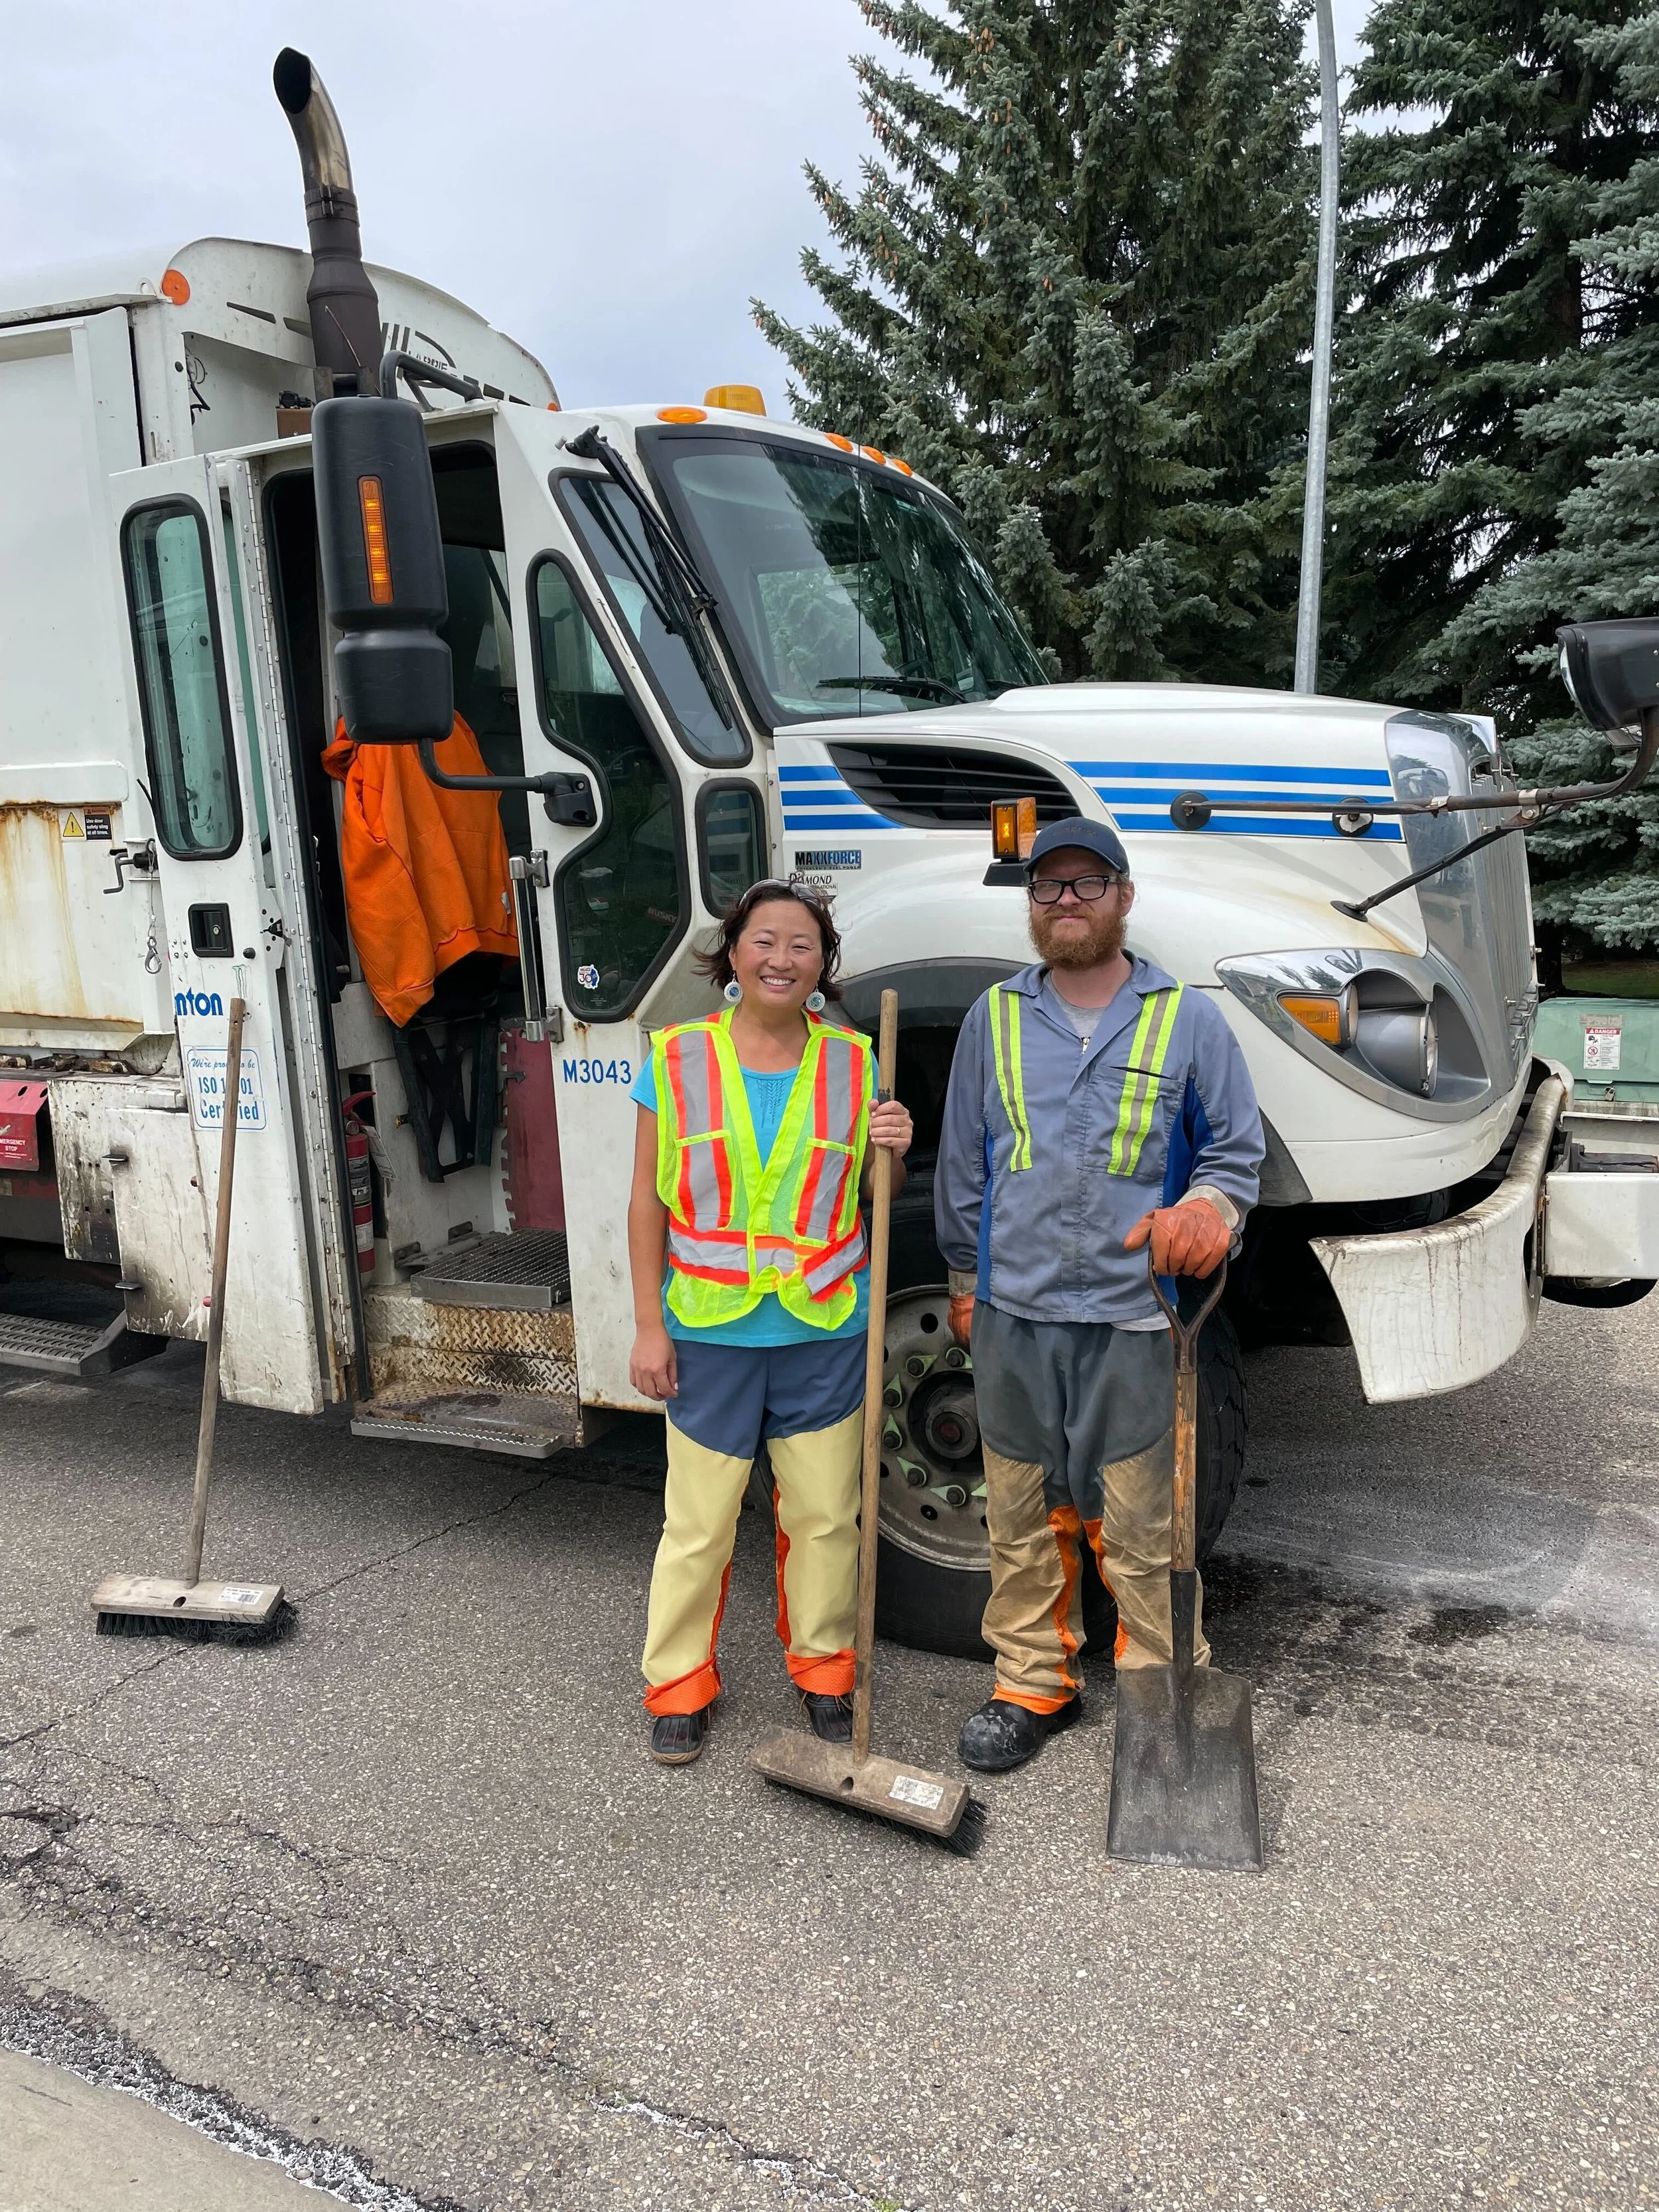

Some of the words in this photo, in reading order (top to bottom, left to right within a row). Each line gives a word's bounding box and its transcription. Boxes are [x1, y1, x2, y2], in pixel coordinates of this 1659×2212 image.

[796, 851, 860, 865] MAXXFORCE
[648, 907, 677, 922] HUSKY
[579, 974, 591, 982] 30
[175, 987, 224, 1016] nton
[248, 1059, 255, 1069] be
[563, 1059, 631, 1084] M3043
[198, 1077, 217, 1094] ISO
[220, 1078, 253, 1094] 101
[200, 1099, 259, 1120] Ceried
